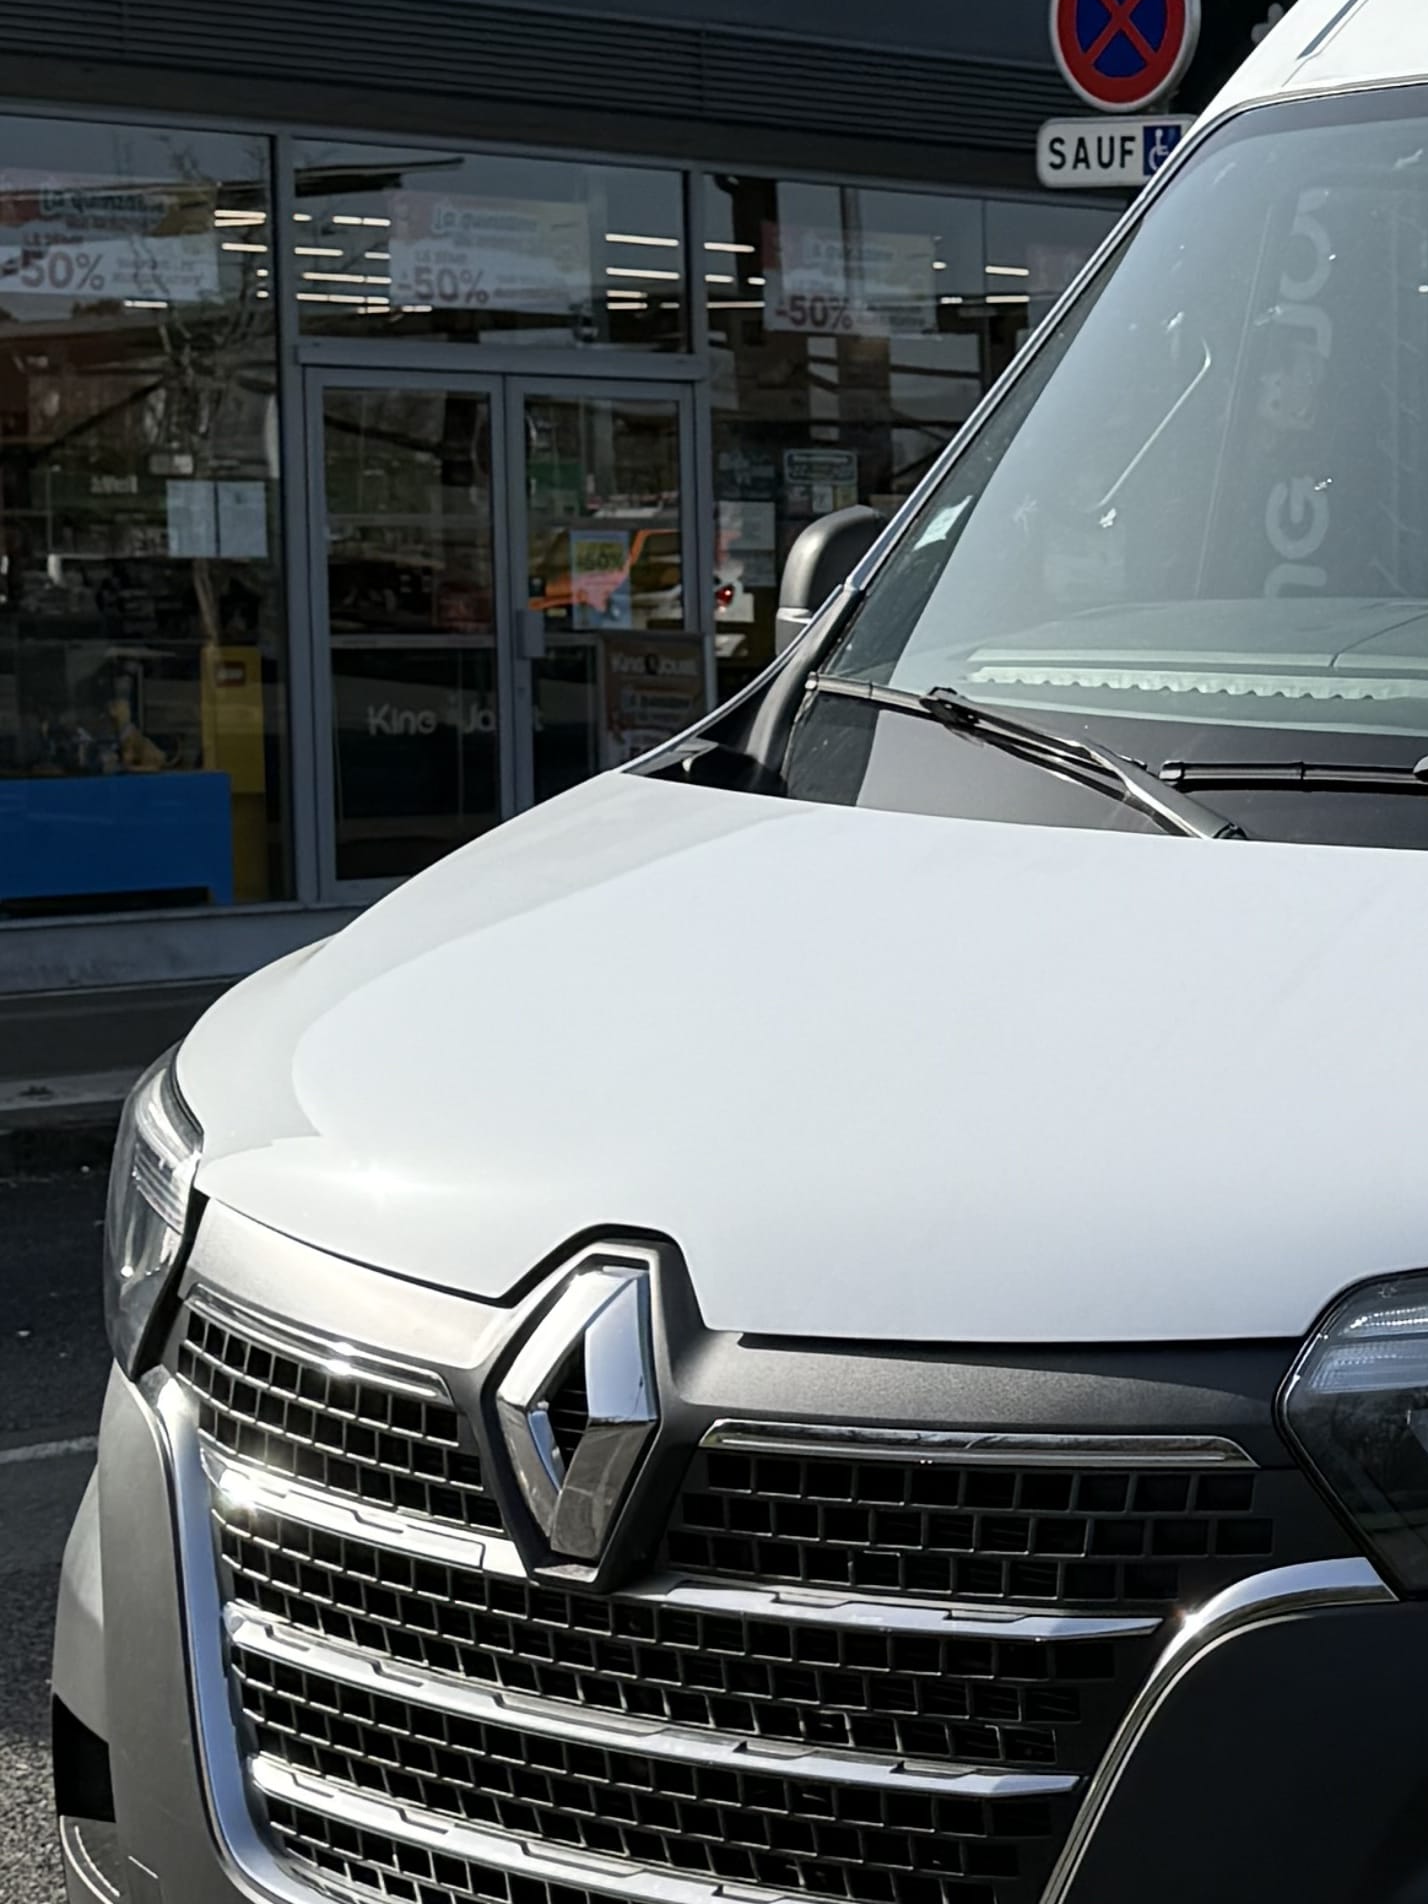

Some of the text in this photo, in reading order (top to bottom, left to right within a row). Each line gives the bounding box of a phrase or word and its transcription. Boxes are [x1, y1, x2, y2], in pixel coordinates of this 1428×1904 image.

[1048, 134, 1137, 171] SAUF
[397, 265, 490, 305] -50%
[775, 294, 854, 330] -50%
